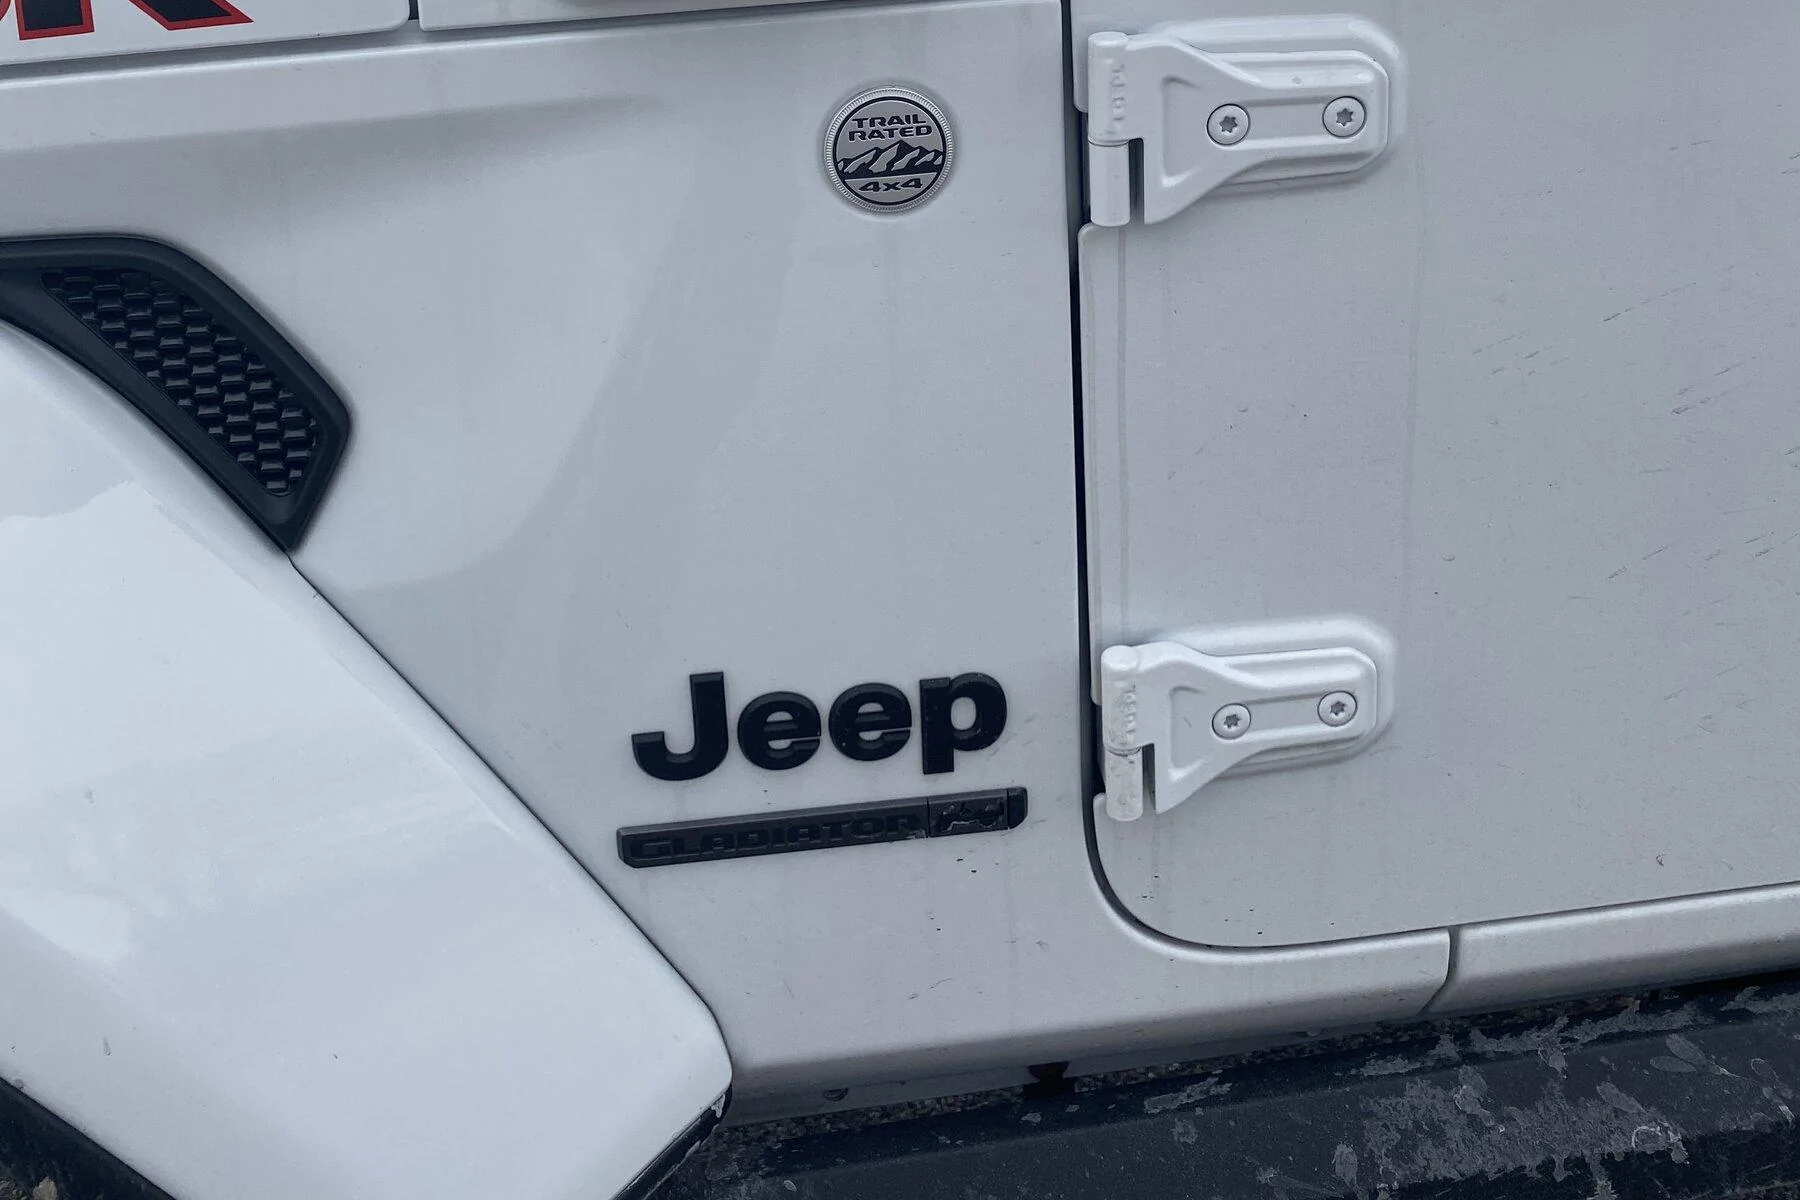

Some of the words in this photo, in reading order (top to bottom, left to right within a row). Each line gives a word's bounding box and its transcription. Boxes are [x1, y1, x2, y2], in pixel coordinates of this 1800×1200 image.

[848, 125, 932, 142] RATED
[851, 114, 927, 129] TRAIL
[631, 671, 1008, 781] Jeep
[629, 814, 924, 862] GLADIATOR
